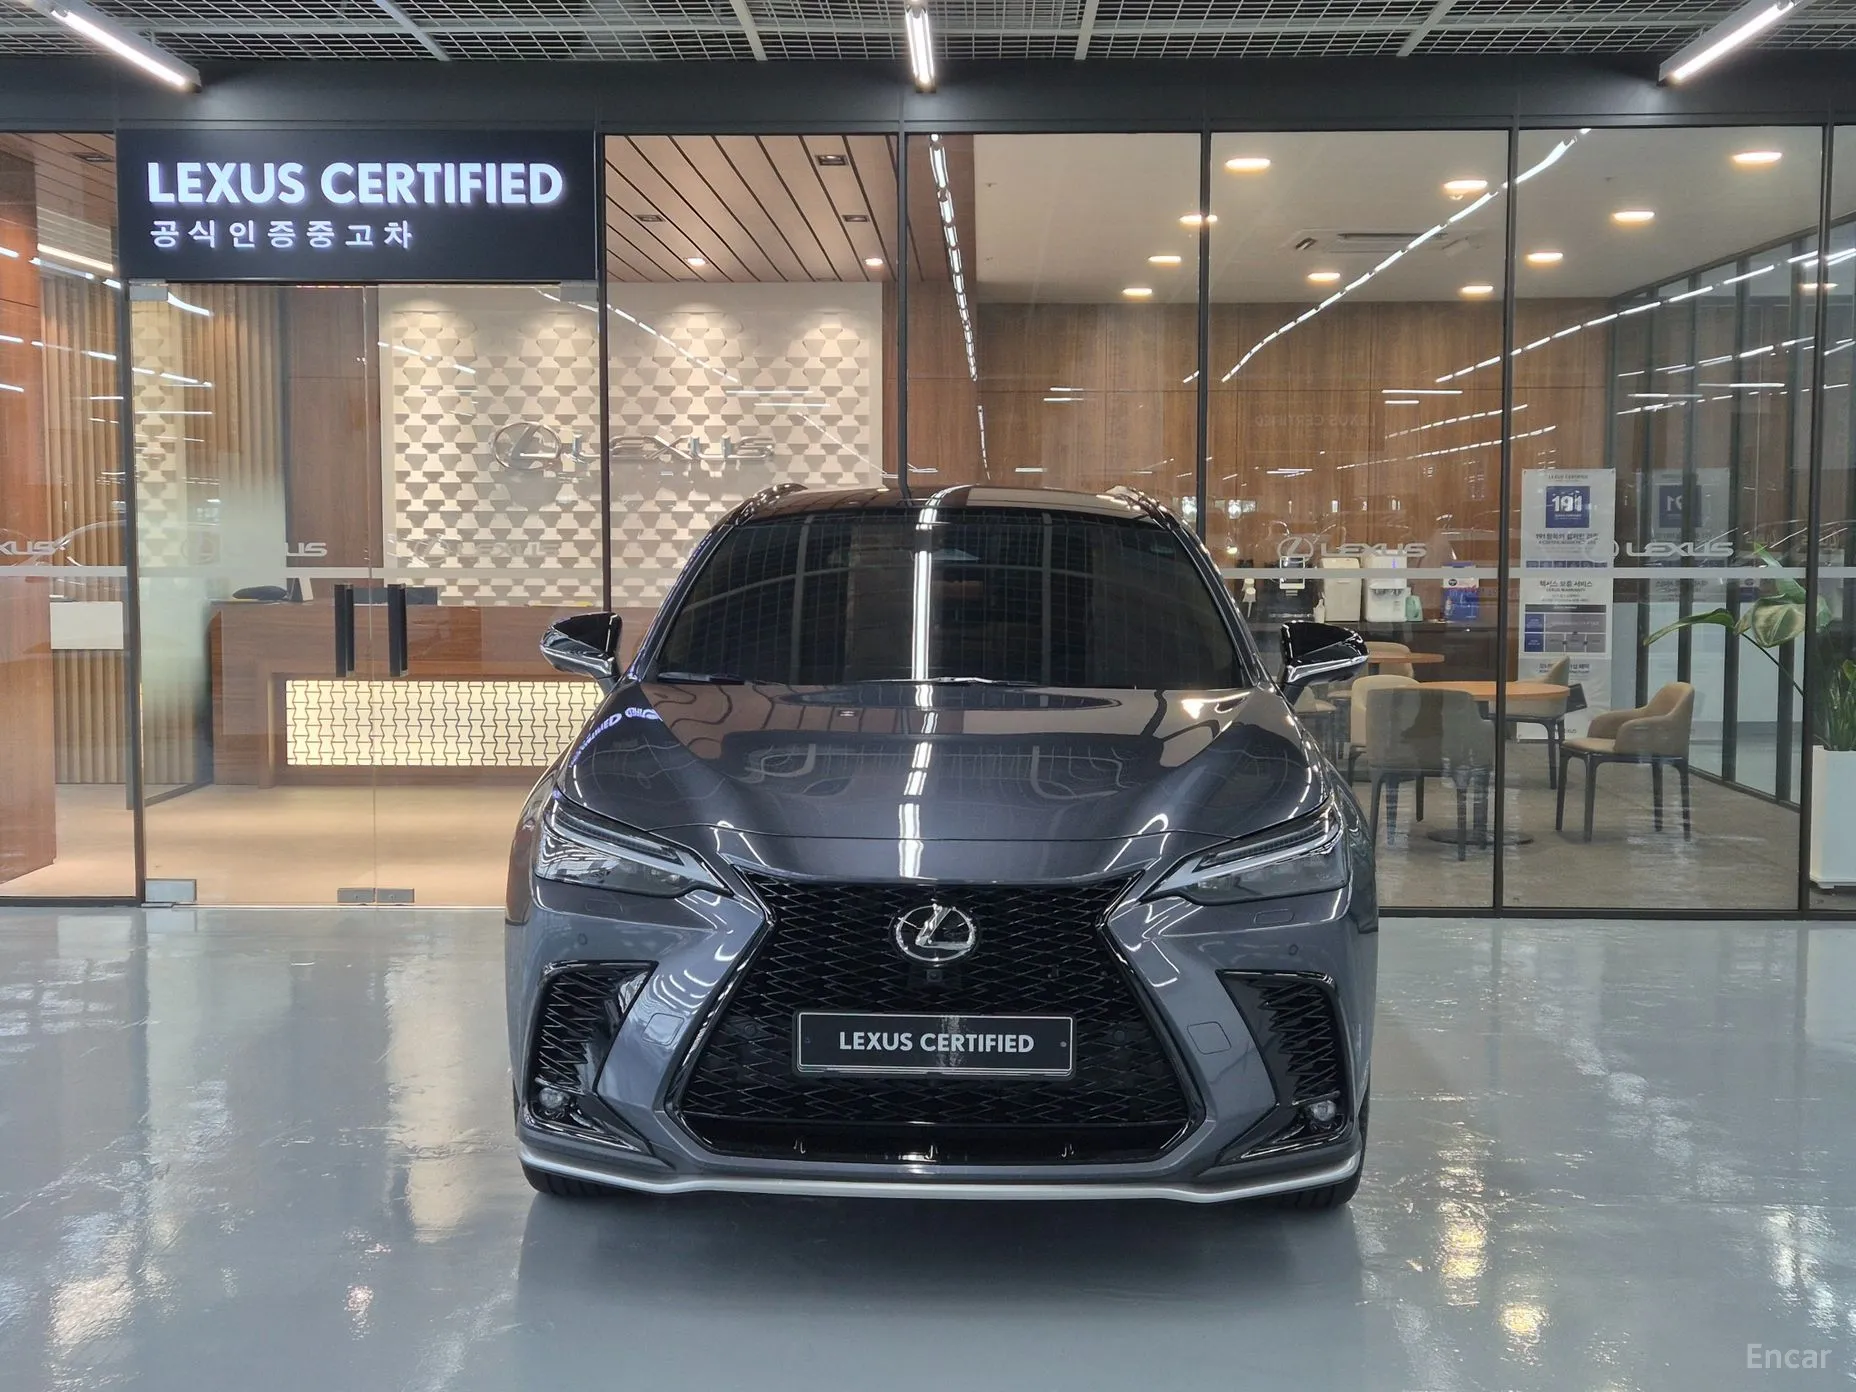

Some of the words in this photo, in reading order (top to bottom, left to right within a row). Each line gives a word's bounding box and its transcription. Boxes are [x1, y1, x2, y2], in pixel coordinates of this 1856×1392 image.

[147, 161, 305, 204] LEXUS
[320, 161, 564, 204] CERTIFIED
[571, 433, 775, 464] LEXUS
[1552, 495, 1582, 512] 191
[1321, 542, 1427, 557] LEXUS
[1626, 541, 1734, 557] LEXUS
[839, 1031, 913, 1052] LEXUS
[919, 1032, 1035, 1054] CERTIFIED
